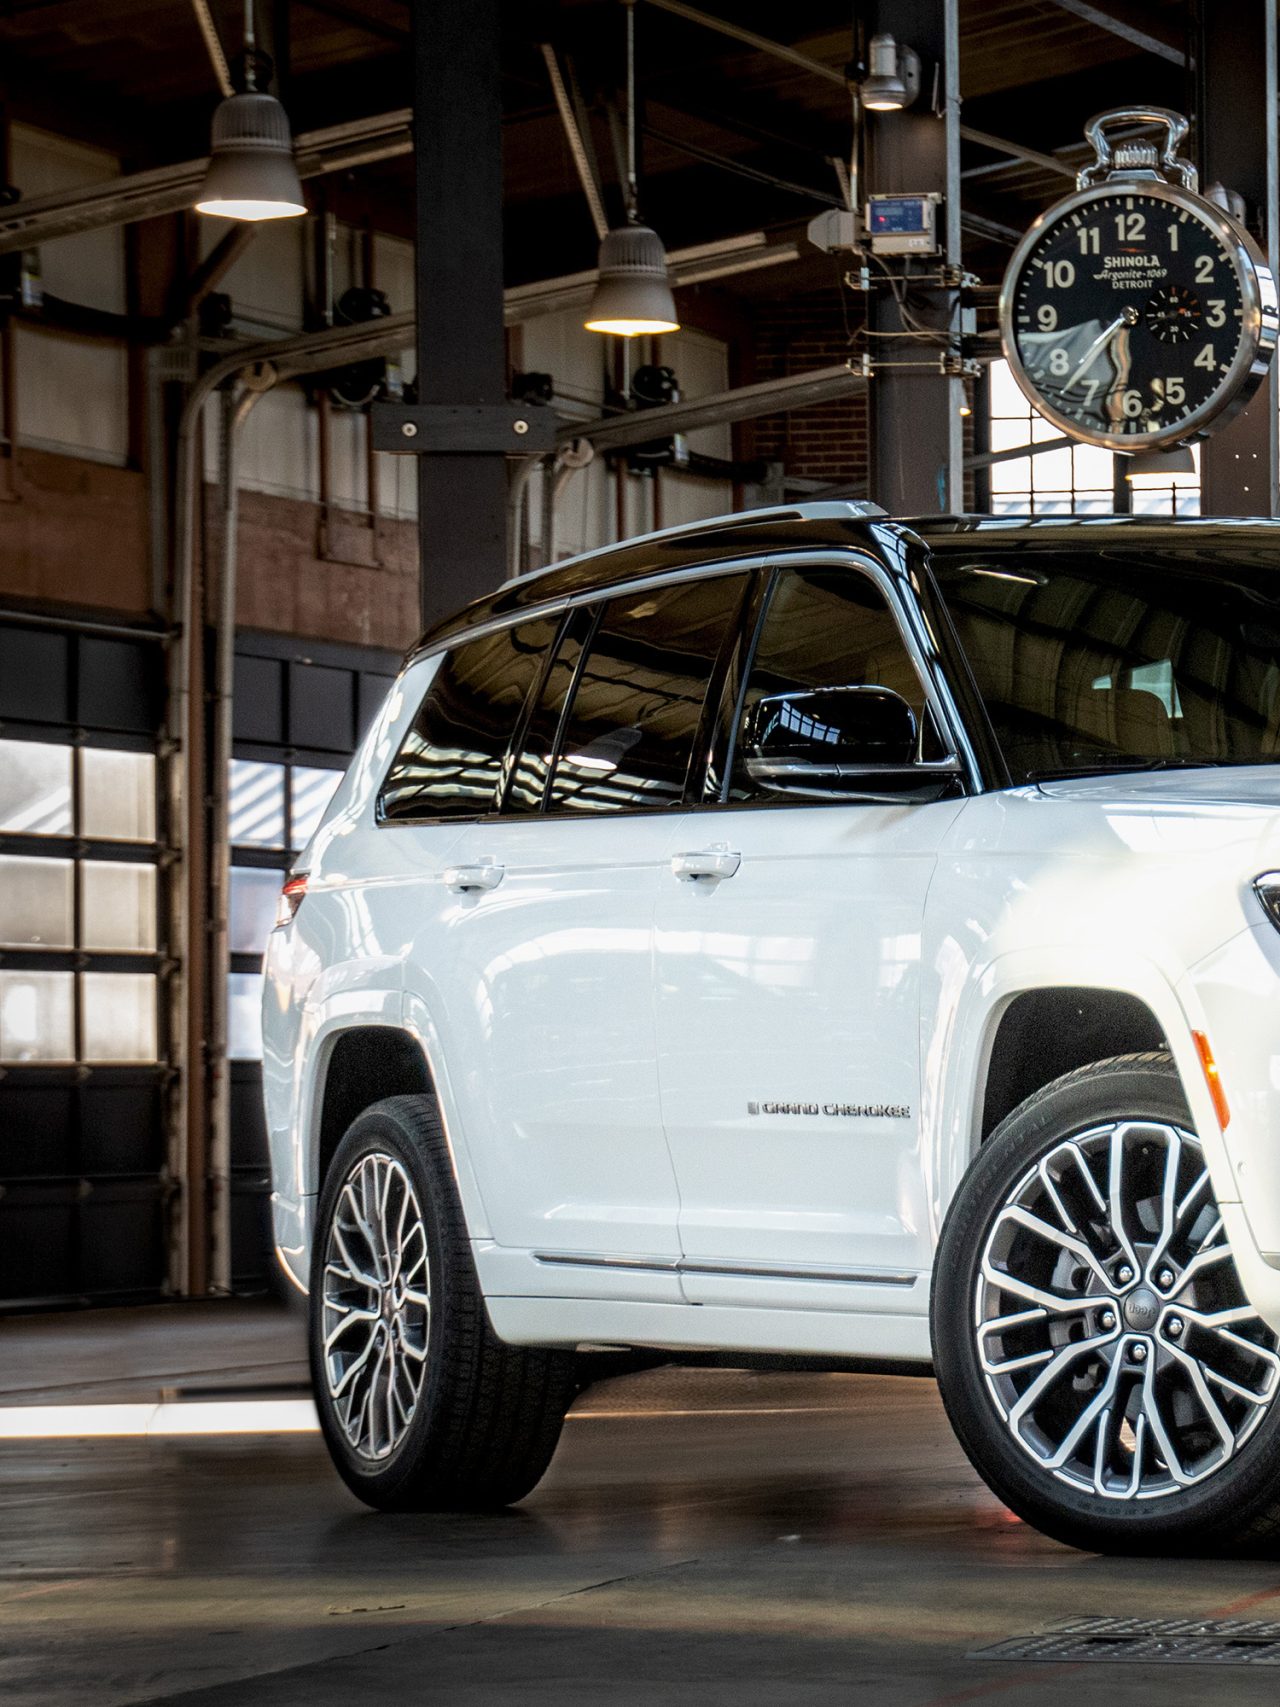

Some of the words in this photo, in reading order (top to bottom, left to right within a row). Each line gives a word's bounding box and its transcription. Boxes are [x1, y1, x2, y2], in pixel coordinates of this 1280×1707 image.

[1076, 227, 1100, 255] 11
[1114, 213, 1146, 241] 12
[1167, 224, 1178, 252] 1
[1044, 260, 1075, 288] 10
[1104, 255, 1161, 268] SHINOLA
[1195, 255, 1215, 284] 2
[1112, 279, 1153, 289] DETROIT
[1037, 304, 1058, 332] 9
[1206, 299, 1227, 328] 3
[1049, 348, 1069, 376] 8
[1194, 344, 1217, 372] 4
[1080, 379, 1100, 407] 7
[1122, 390, 1143, 418] 6
[1165, 377, 1186, 405] 5
[762, 1102, 819, 1115] GRAND
[822, 1103, 911, 1119] CHEROKEE
